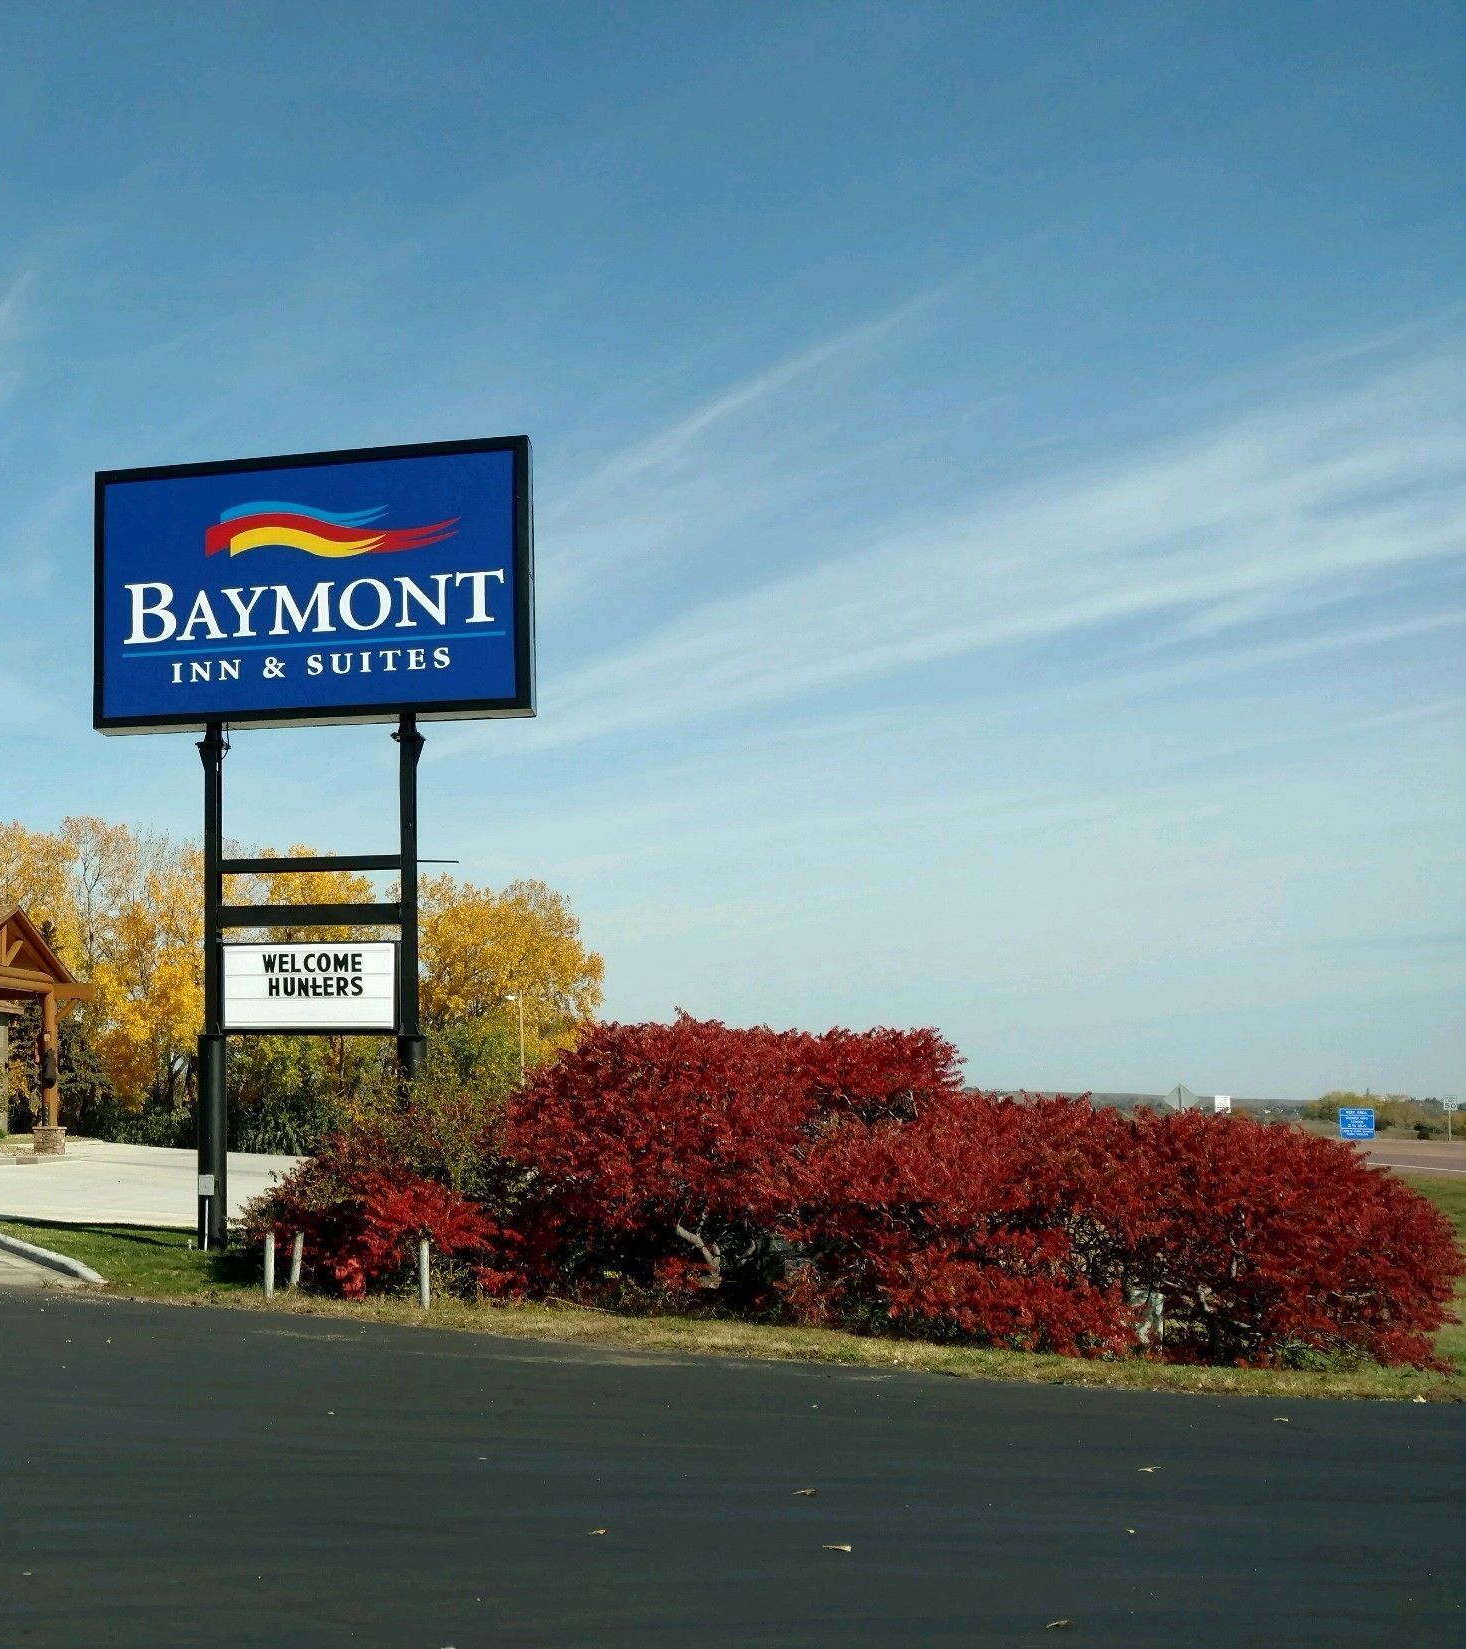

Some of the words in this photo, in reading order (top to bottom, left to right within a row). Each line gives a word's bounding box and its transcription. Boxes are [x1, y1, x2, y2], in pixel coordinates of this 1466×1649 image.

[123, 568, 504, 645] BAYMONT
[172, 658, 241, 683] INN
[262, 656, 286, 679] &
[307, 647, 451, 676] SUITES
[262, 953, 363, 973] WELCOME
